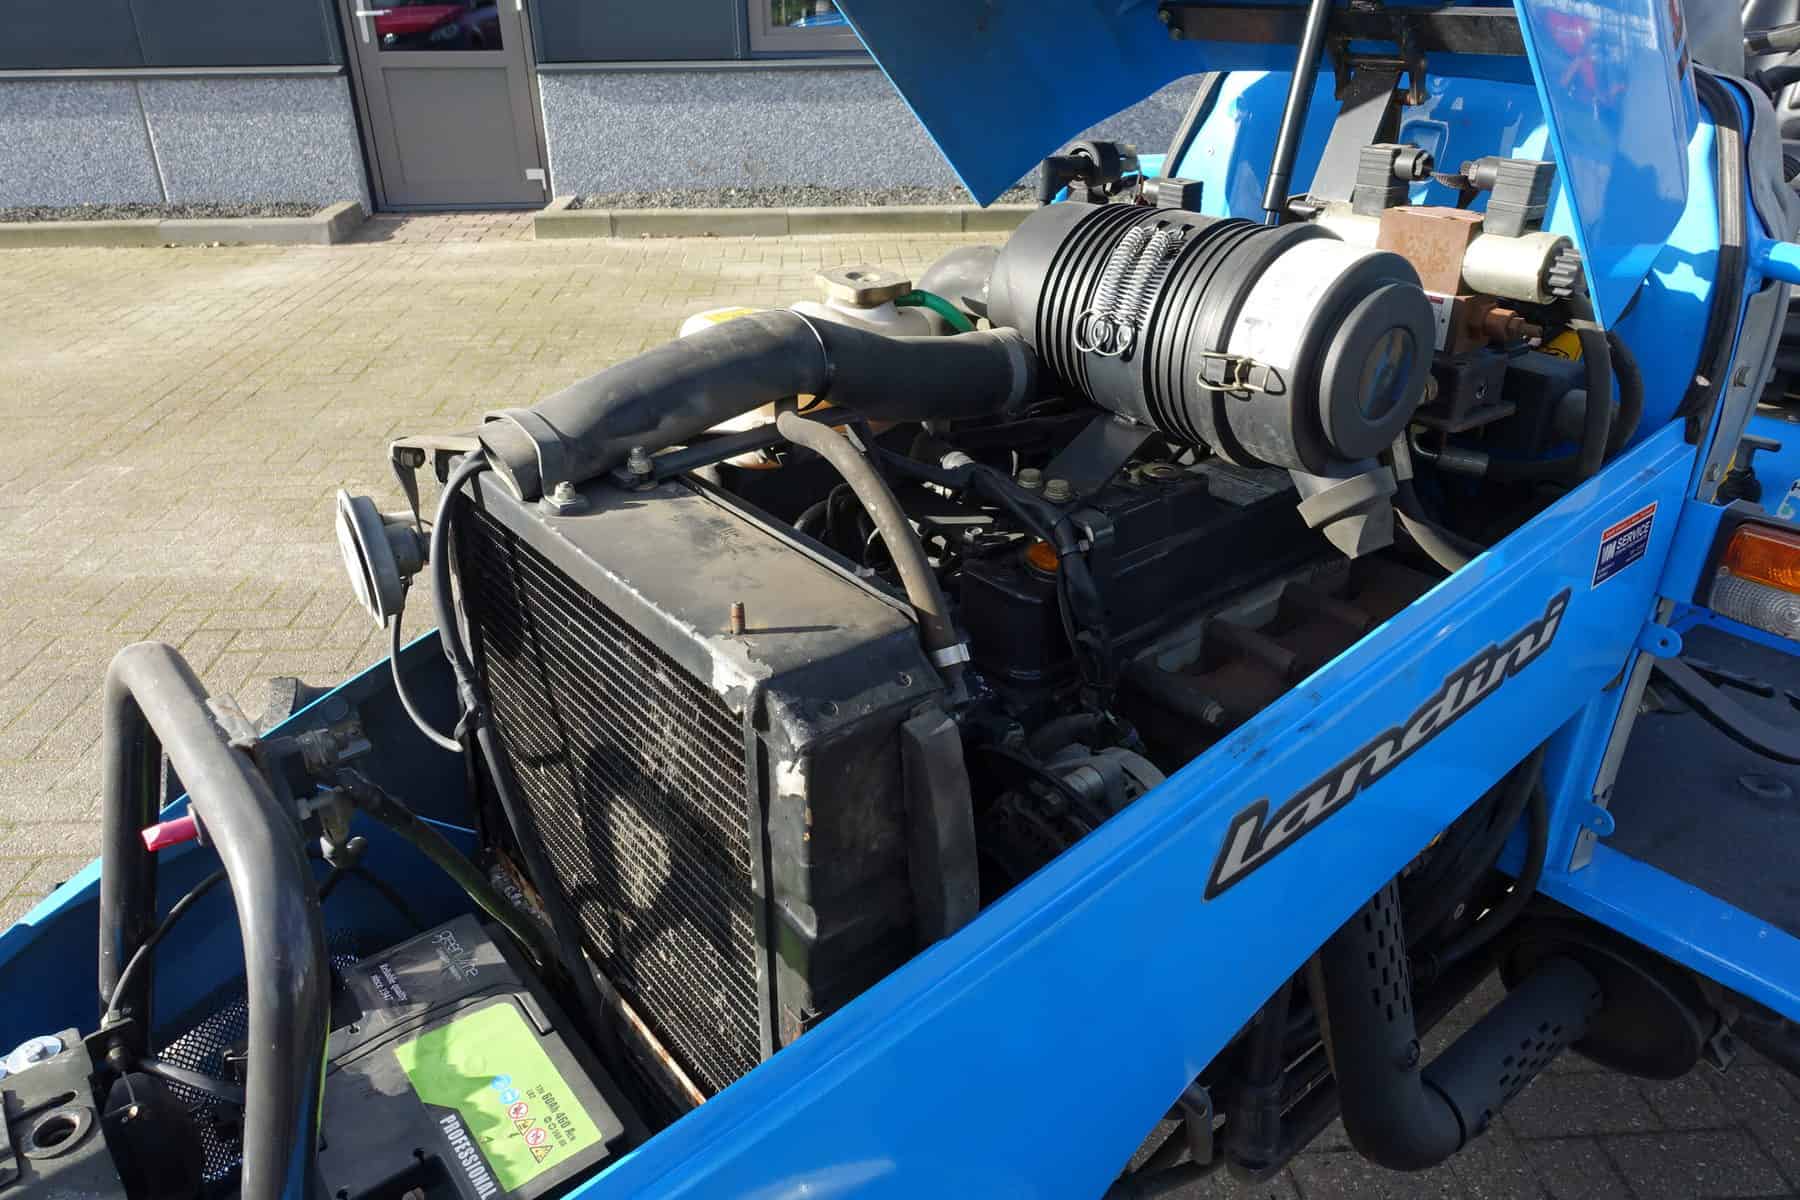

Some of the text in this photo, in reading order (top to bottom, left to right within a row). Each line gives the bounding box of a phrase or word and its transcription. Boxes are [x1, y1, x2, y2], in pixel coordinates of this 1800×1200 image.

[1617, 520, 1651, 549] SERVICE
[1211, 593, 1567, 893] Landini
[541, 1092, 560, 1113] 60Ah
[556, 1112, 572, 1129] 460
[440, 1113, 497, 1200] PROFESSIONAL
